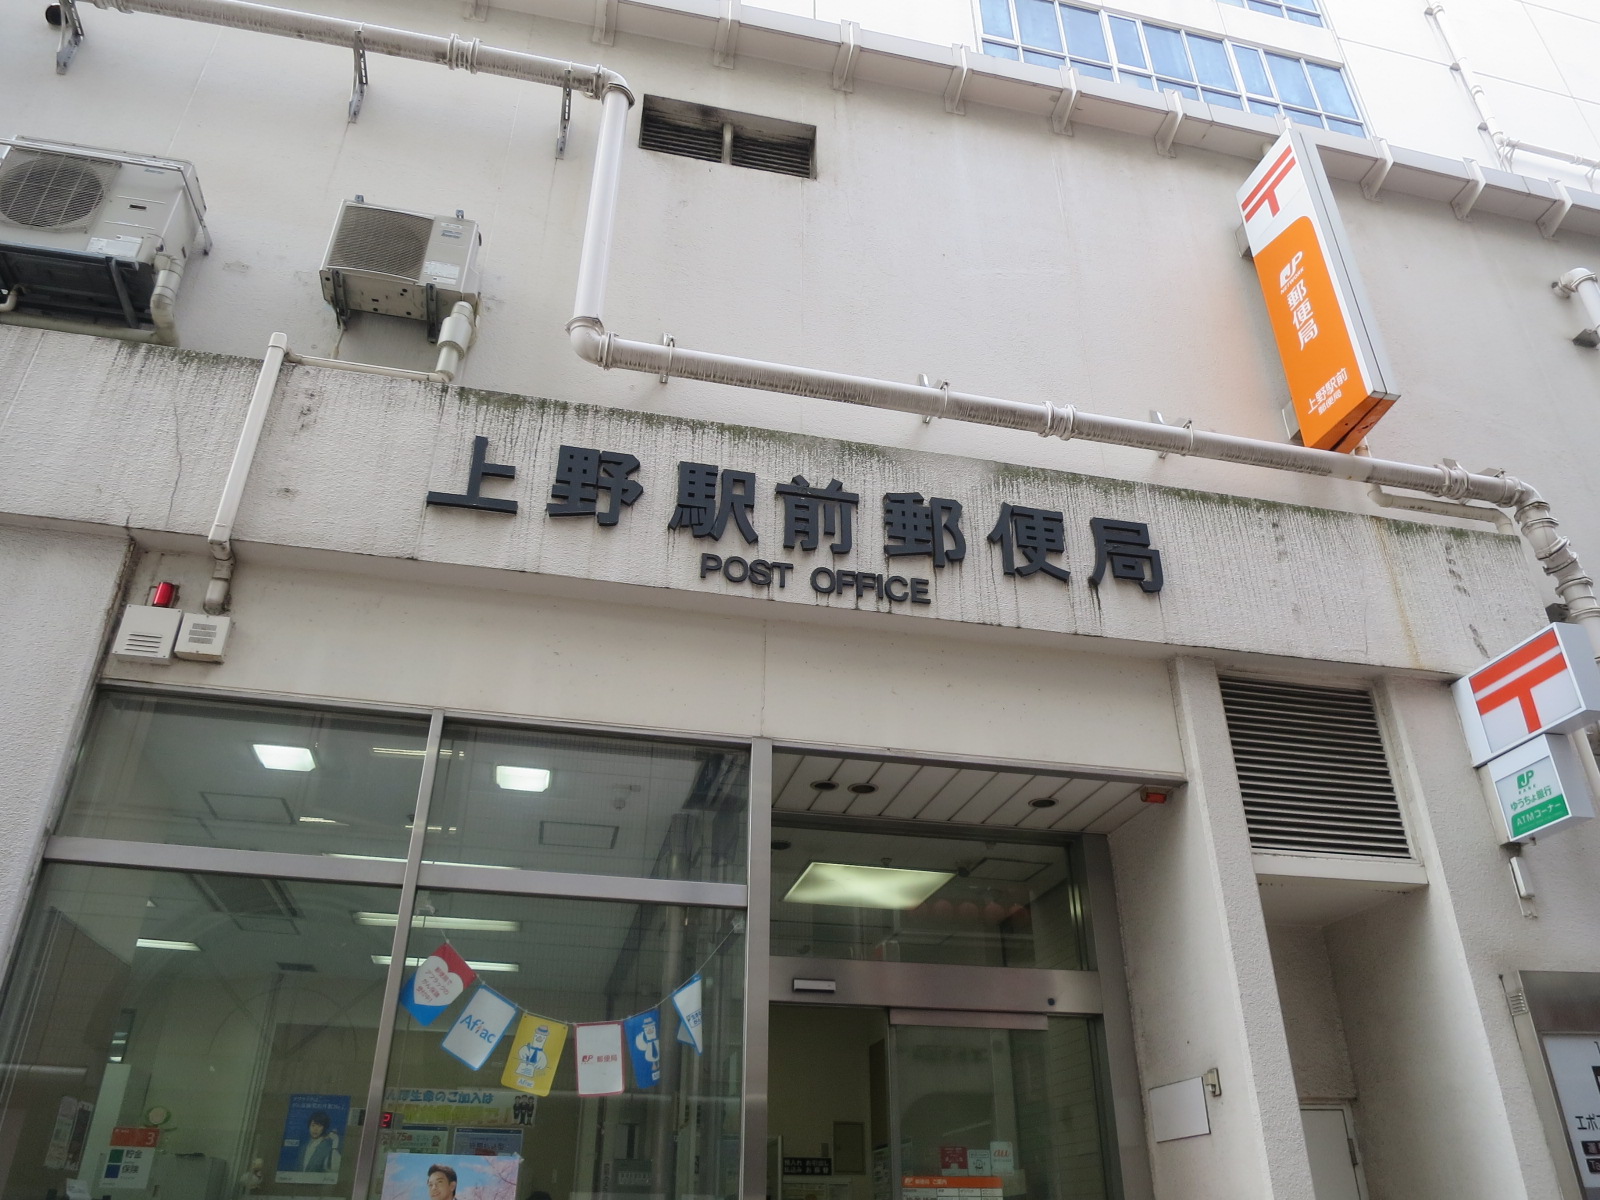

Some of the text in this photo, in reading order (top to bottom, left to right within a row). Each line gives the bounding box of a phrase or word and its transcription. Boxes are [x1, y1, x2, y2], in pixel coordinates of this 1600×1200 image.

[1287, 279, 1320, 351] 郵便局
[1307, 367, 1348, 414] 上野駅前
[1318, 389, 1343, 416] 郵便局
[426, 435, 1164, 593] 上野駅前郵便局
[700, 552, 931, 604] POST OFFICE
[1510, 785, 1552, 811] ゆうちょ銀行
[1517, 803, 1561, 826] ATMコーナー
[460, 1014, 497, 1044] Aflac
[596, 1054, 618, 1063] 郵便局
[146, 1132, 156, 1145] 3
[126, 1149, 143, 1159] 貯金
[993, 1149, 1010, 1158] au
[122, 1164, 139, 1174] 保険
